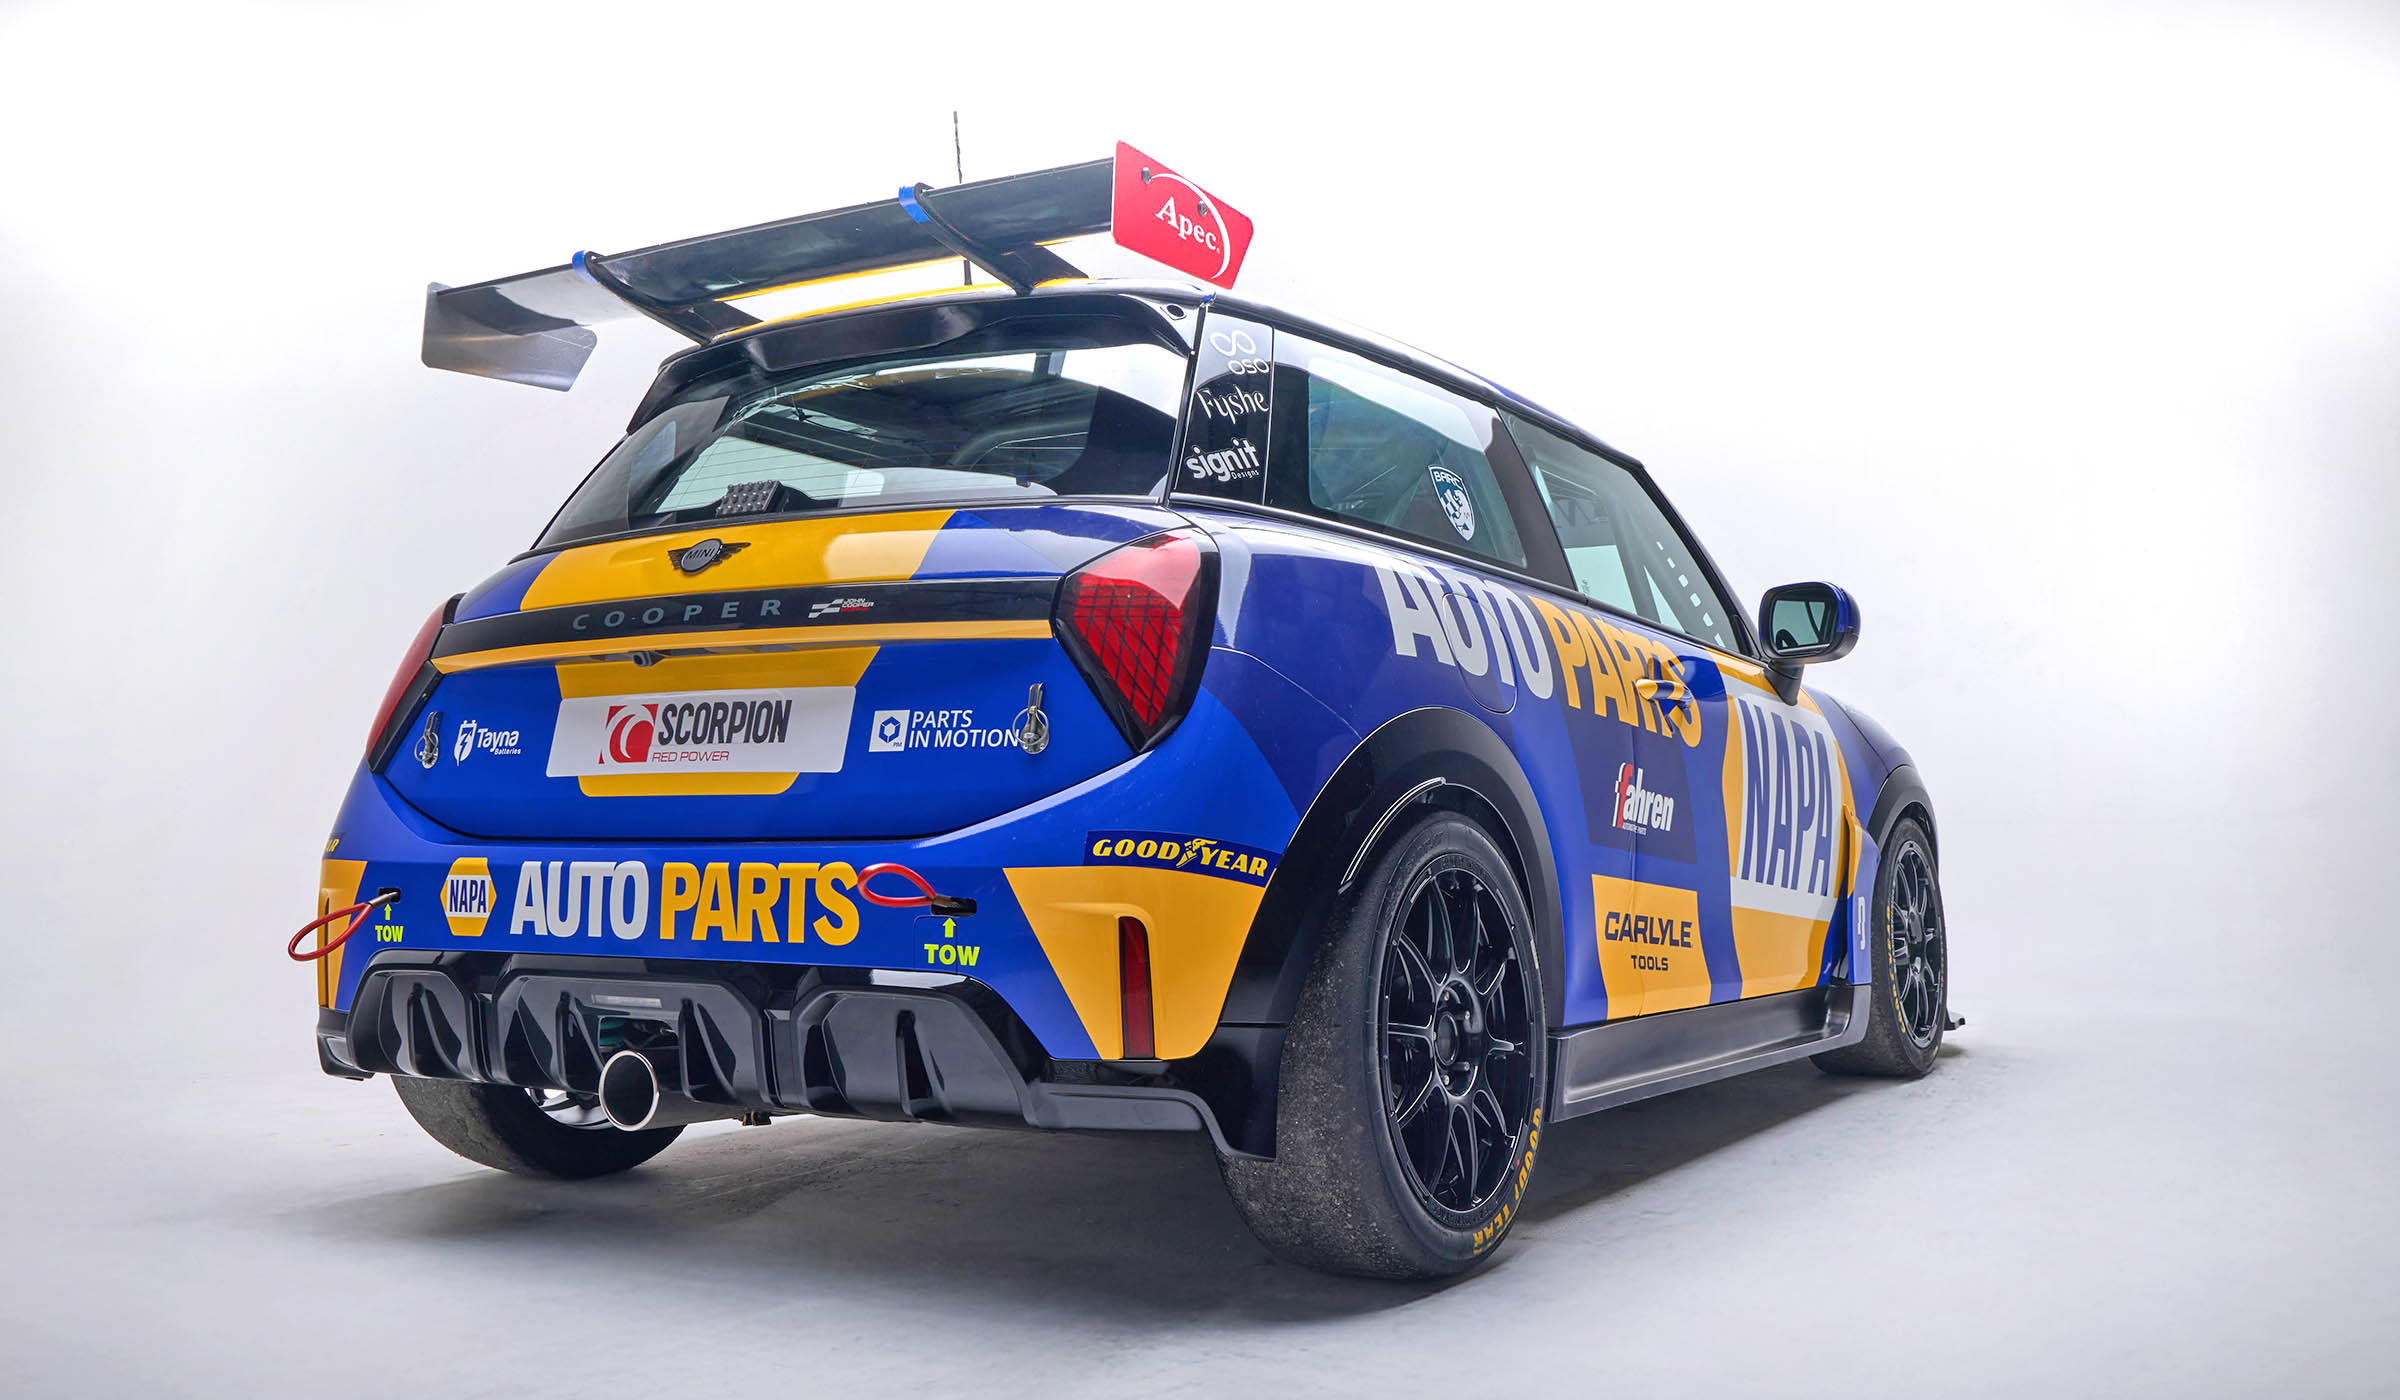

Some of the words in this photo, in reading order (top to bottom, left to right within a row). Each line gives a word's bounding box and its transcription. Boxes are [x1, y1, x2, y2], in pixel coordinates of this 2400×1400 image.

[1197, 384, 1270, 425] Fyshe
[1186, 438, 1260, 482] signit
[1433, 470, 1463, 491] BARC
[686, 547, 716, 560] MINI
[572, 599, 781, 631] COOPER
[1374, 564, 1554, 699] AUTO
[1528, 595, 1702, 748] PARTS
[658, 699, 793, 746] SCORPION
[911, 709, 973, 729] PARTS
[477, 728, 520, 752] Tayna
[908, 730, 931, 748] IN
[934, 729, 1020, 748] MOTION
[651, 752, 678, 764] RED
[679, 750, 730, 763] POWER
[1738, 697, 1833, 897] NAPA
[449, 878, 488, 914] NAPA
[509, 860, 650, 941] AUTO
[659, 861, 860, 946] PARTS
[374, 924, 404, 943] TOW
[1604, 911, 1693, 949] CARLYLE
[923, 943, 981, 967] TOW
[1631, 954, 1669, 972] TOOLS
